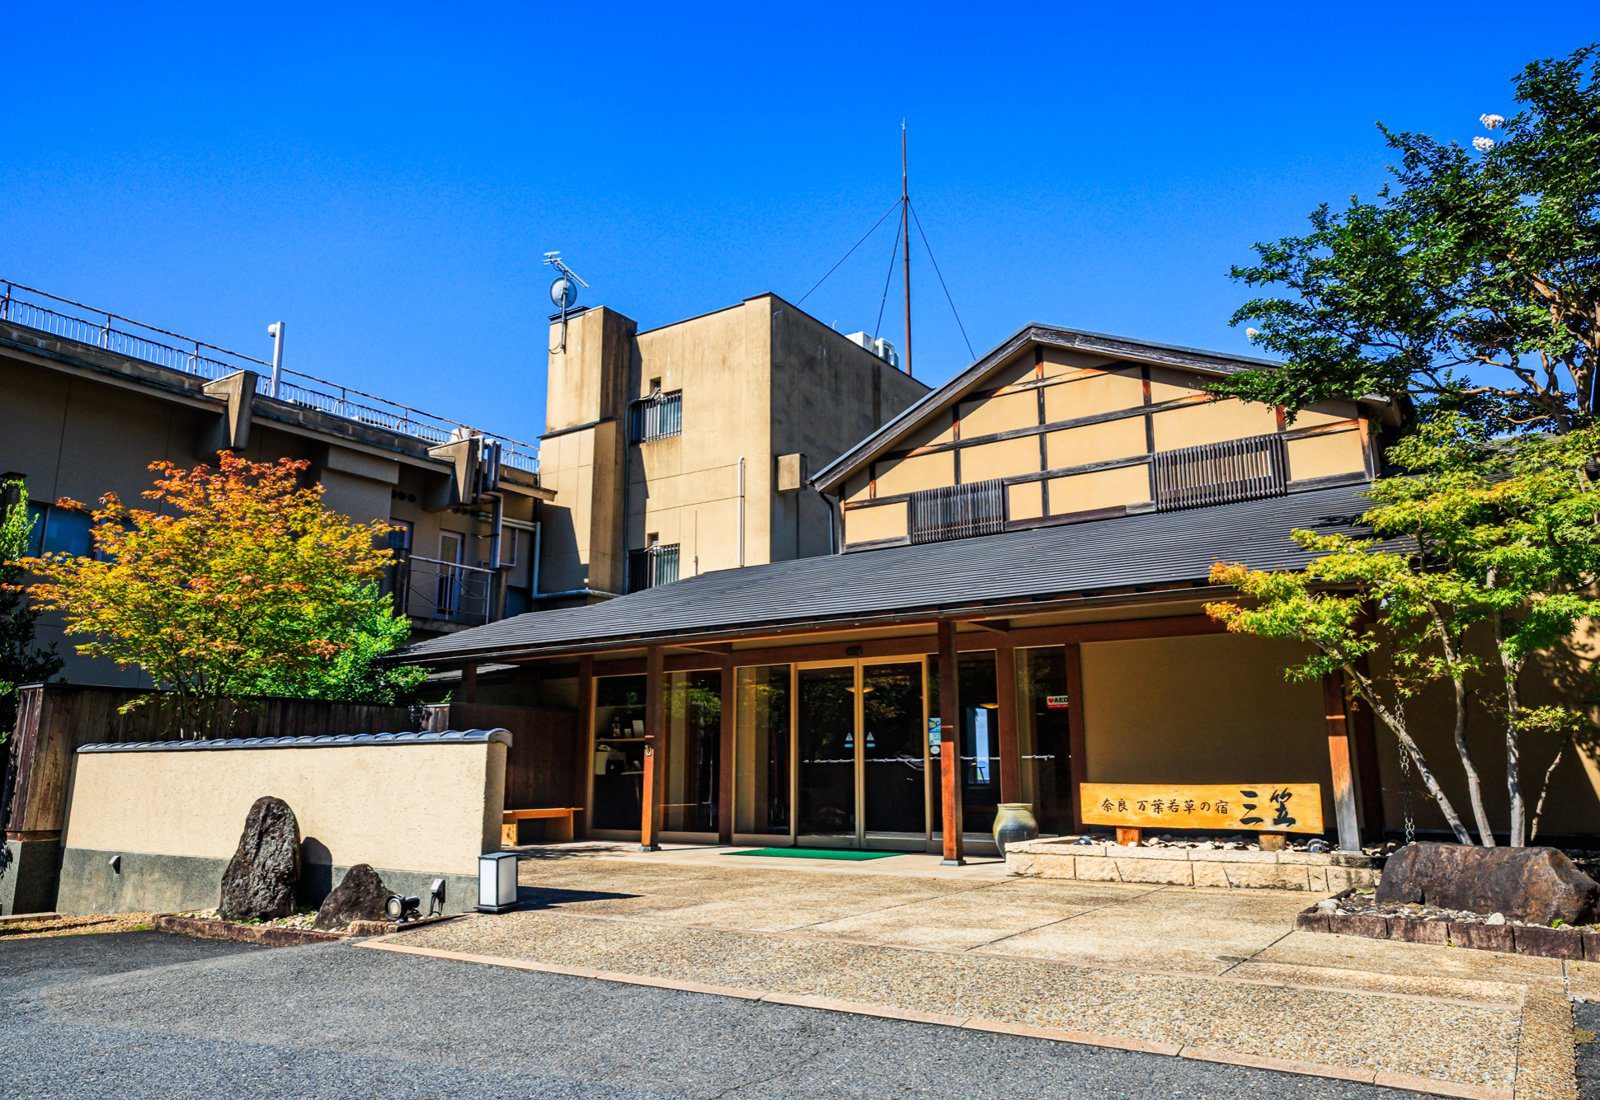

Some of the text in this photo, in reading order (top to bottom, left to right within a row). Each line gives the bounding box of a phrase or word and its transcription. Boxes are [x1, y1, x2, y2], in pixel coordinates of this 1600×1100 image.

[1101, 787, 1297, 827] 奈良 万葉若草の宿 三笠
